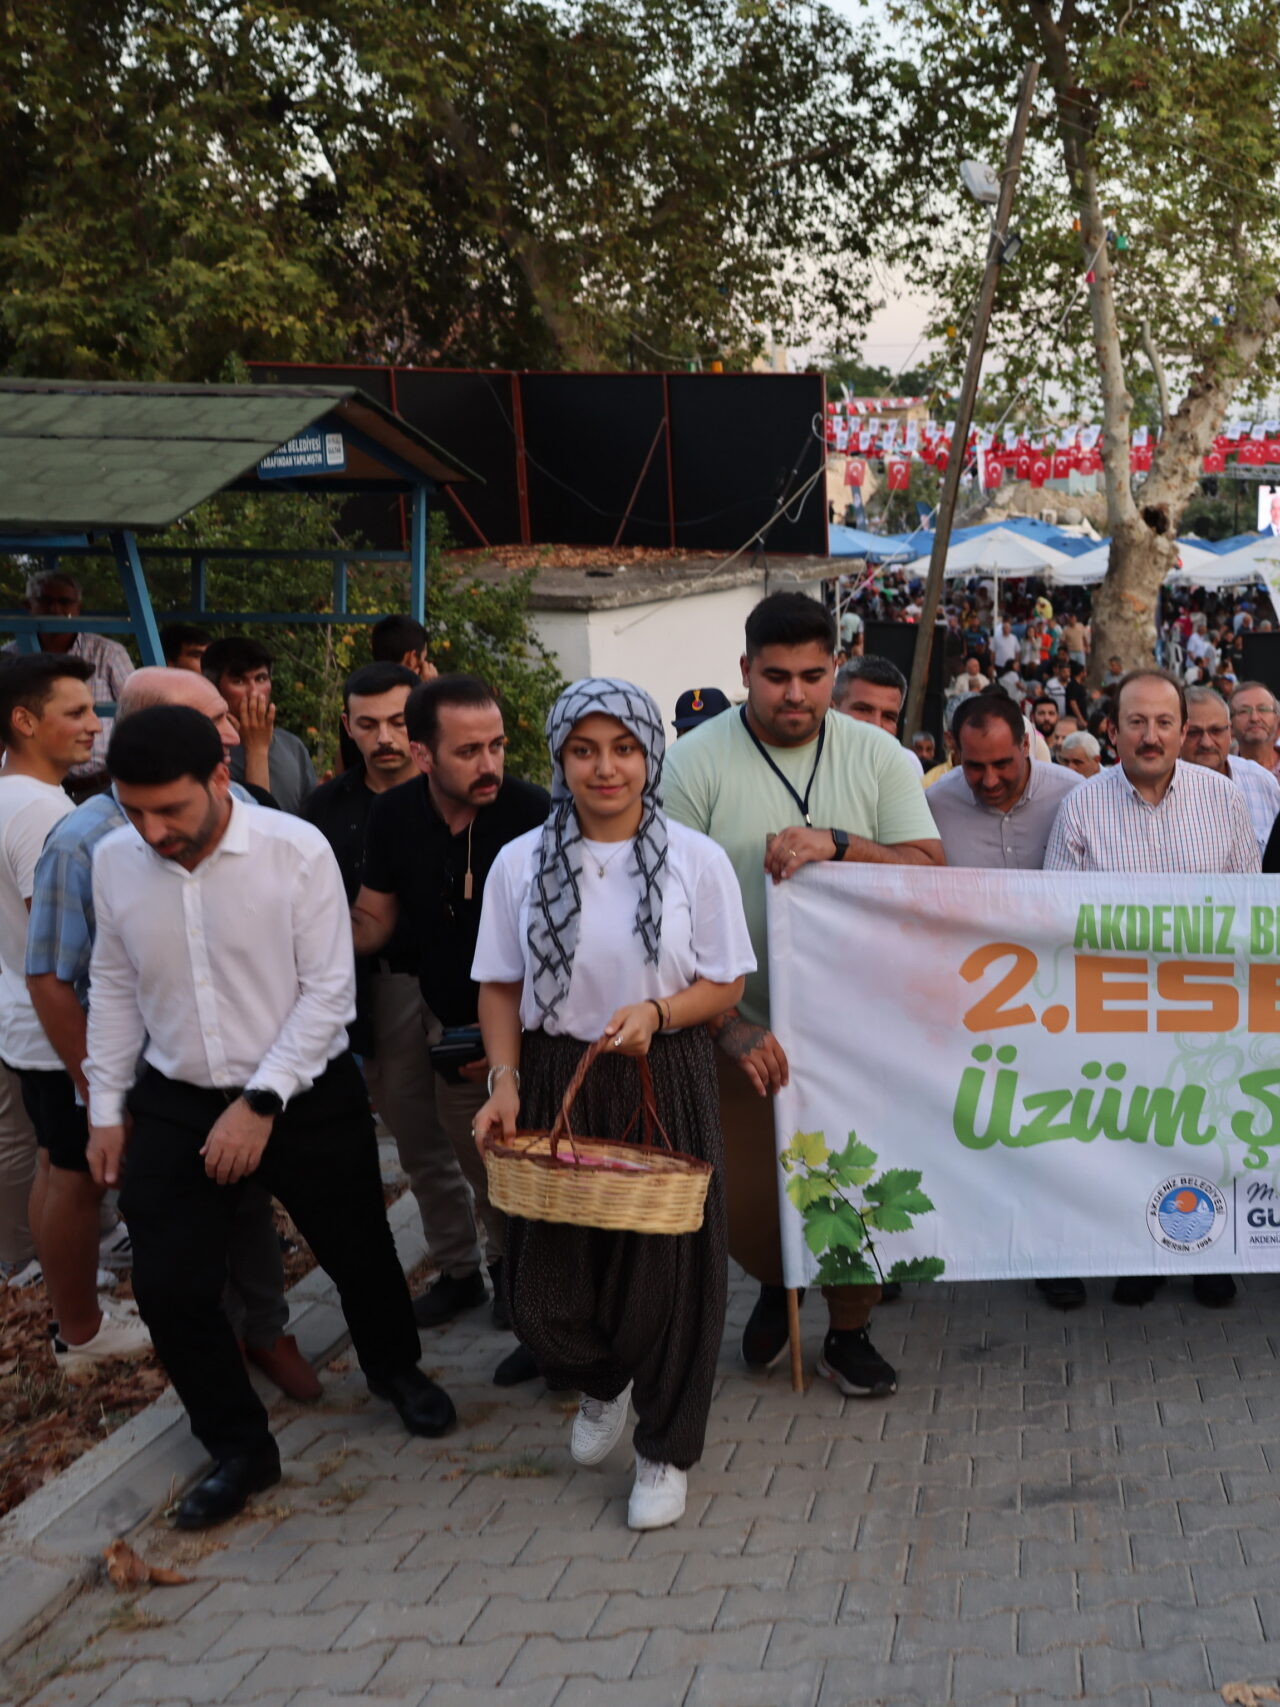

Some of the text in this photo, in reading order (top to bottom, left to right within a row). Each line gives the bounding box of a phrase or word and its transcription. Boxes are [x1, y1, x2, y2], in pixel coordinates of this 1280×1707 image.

[1073, 896, 1236, 954] AKDENİZ
[952, 1043, 1218, 1151] Üzüm
[1150, 1179, 1177, 1217] AKDENİZ
